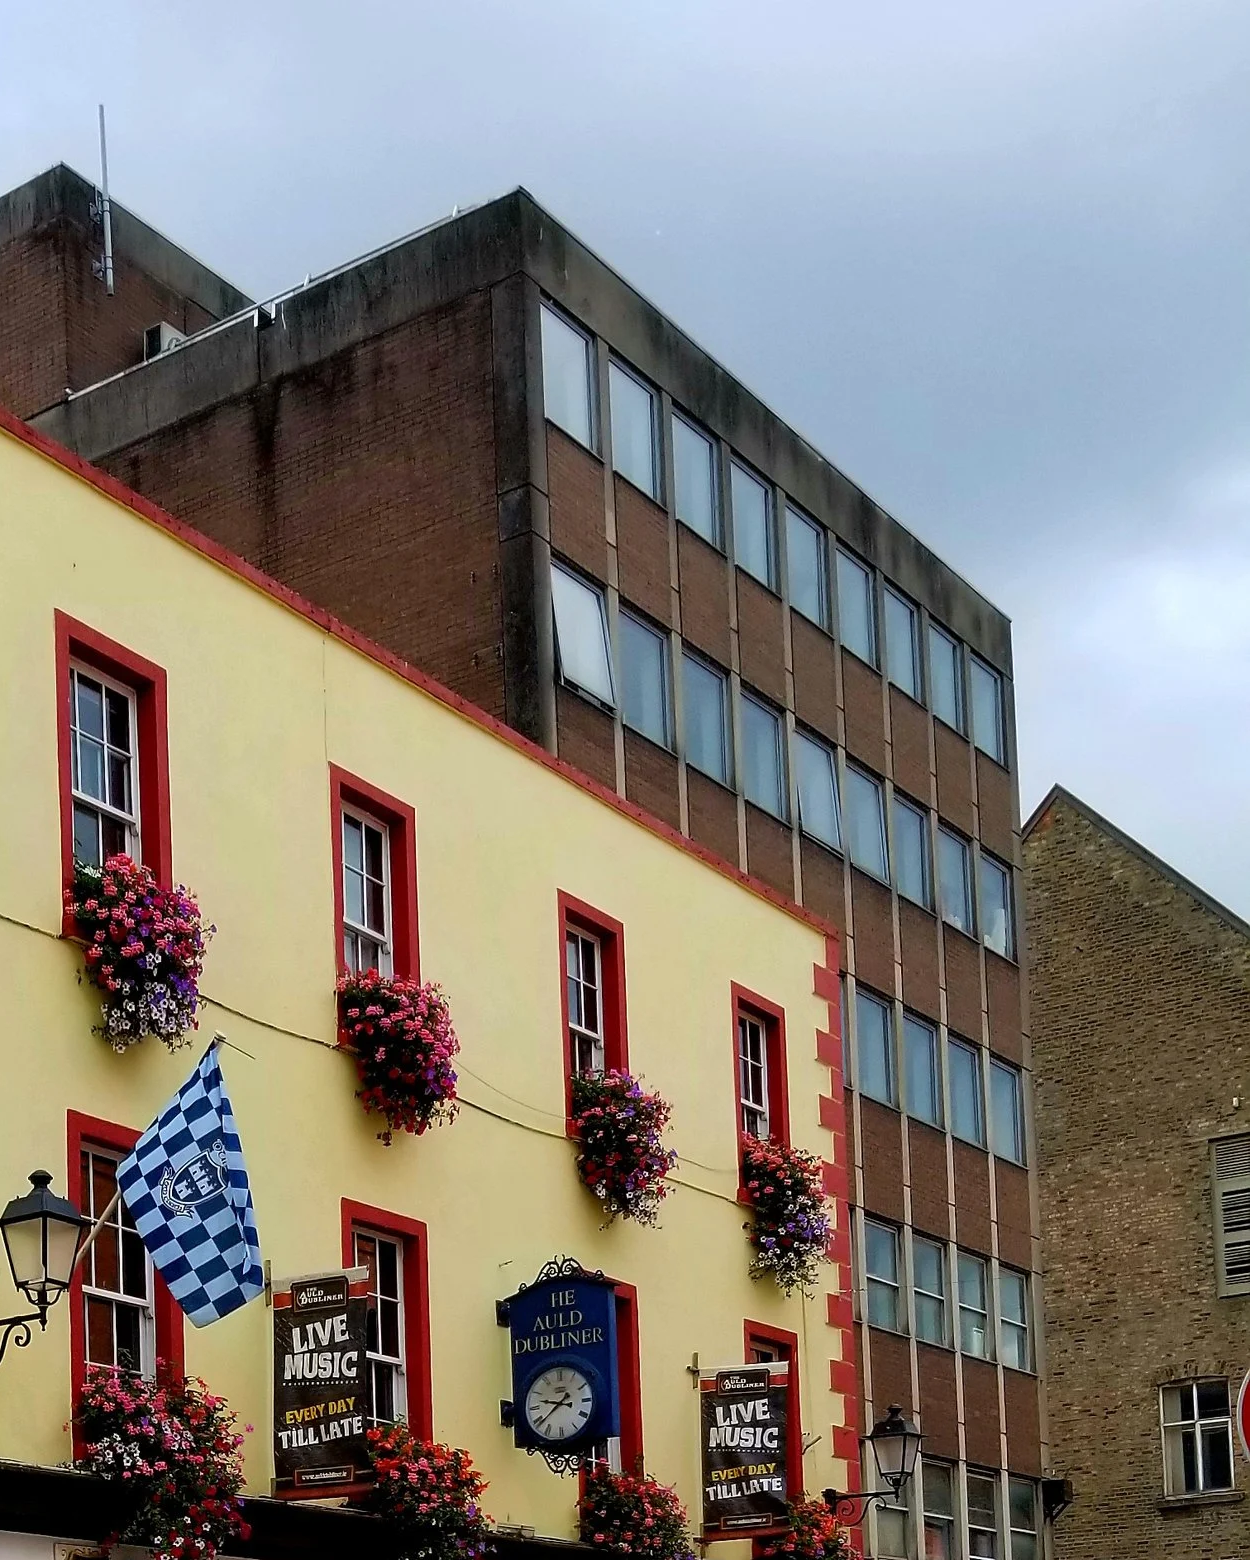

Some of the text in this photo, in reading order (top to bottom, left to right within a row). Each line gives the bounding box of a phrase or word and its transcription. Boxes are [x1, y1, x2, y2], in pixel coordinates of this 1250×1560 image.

[299, 1289, 324, 1300] AULD
[301, 1293, 344, 1305] DUBLINER
[533, 1310, 583, 1332] AULD
[292, 1313, 350, 1354] LIVE
[515, 1327, 604, 1355] DUBLINER
[283, 1350, 359, 1380] MUSIC
[723, 1378, 747, 1387] AULD
[286, 1396, 356, 1425] EVERY DAY
[715, 1398, 771, 1427] LIVE
[278, 1415, 363, 1449] TILL LATE
[708, 1426, 779, 1448] MUSIC
[711, 1462, 777, 1481] EVERY DAY
[705, 1477, 783, 1501] TILL LATE
